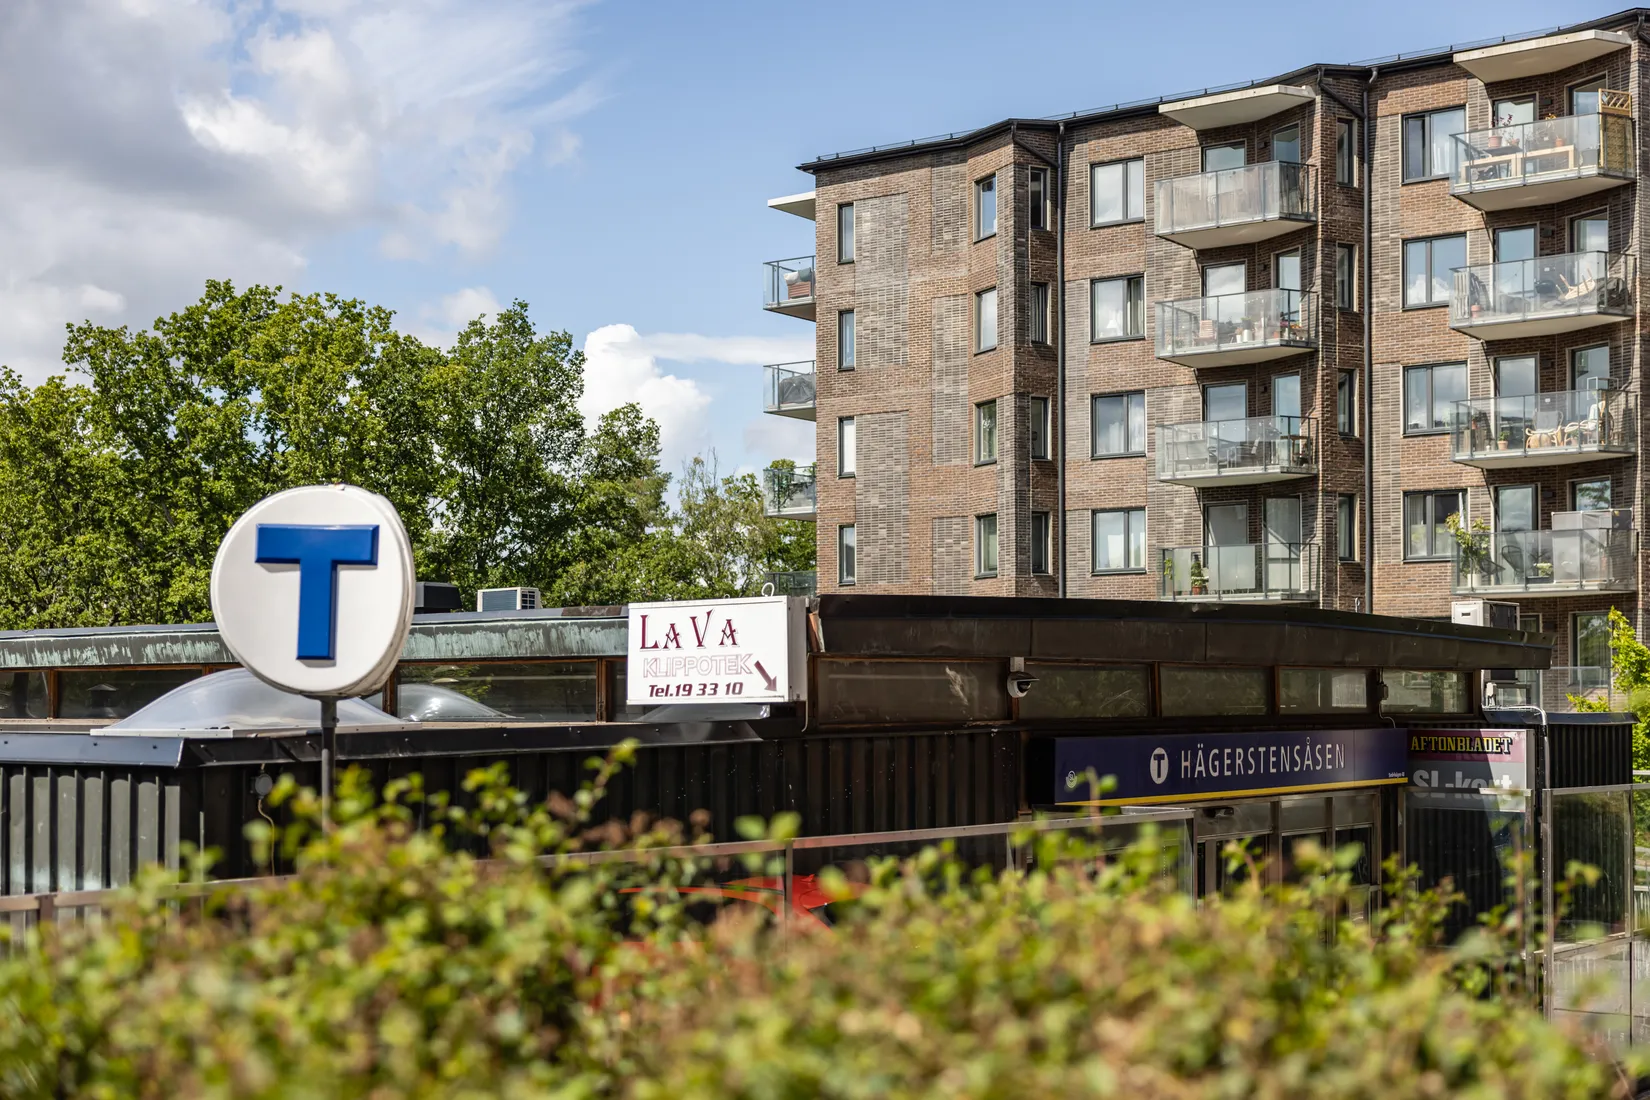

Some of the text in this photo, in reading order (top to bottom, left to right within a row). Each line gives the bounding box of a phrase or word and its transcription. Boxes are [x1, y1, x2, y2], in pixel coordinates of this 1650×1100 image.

[255, 523, 380, 660] T
[643, 653, 753, 678] KLIPPOTEK
[696, 682, 719, 696] 33
[725, 681, 744, 695] 10
[1410, 735, 1512, 754] AFTONBLADET
[1181, 736, 1345, 779] HÄGERSTENSÅSEN
